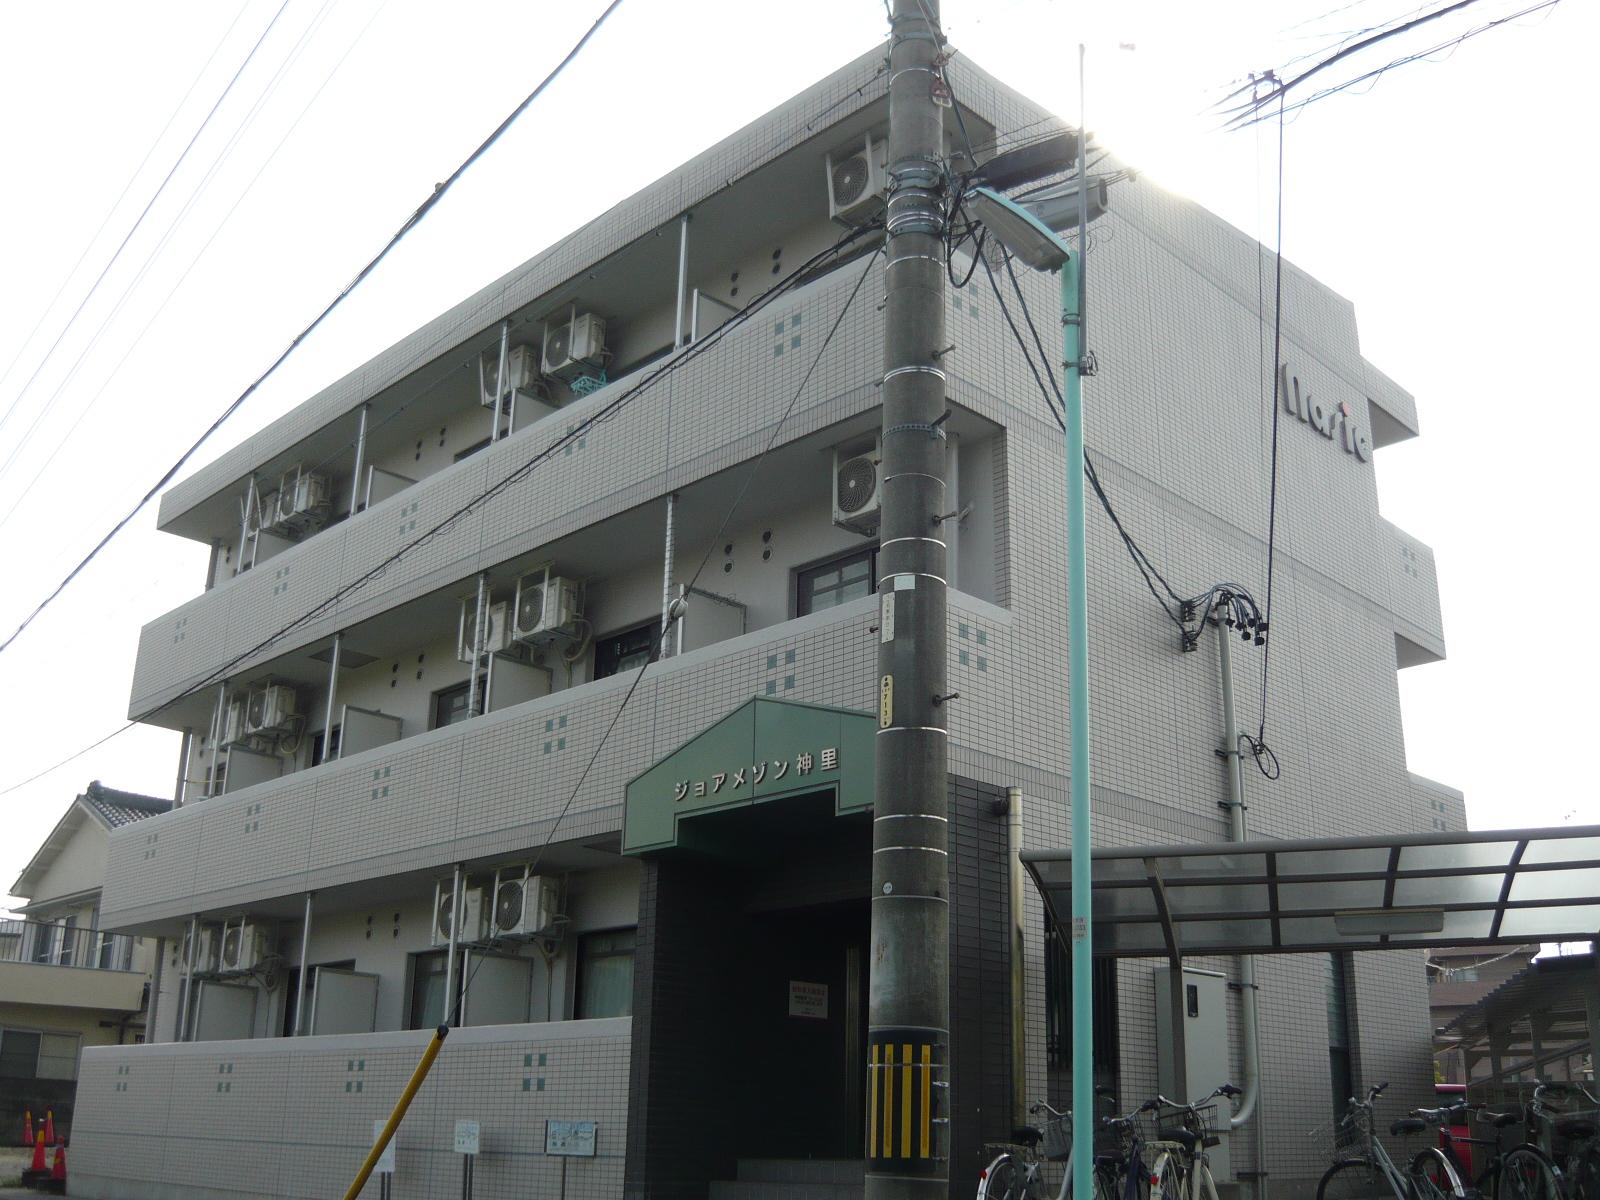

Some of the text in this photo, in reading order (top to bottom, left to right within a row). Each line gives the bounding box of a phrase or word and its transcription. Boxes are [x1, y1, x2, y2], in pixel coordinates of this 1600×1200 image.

[674, 747, 839, 802] ジョアメゾン神里
